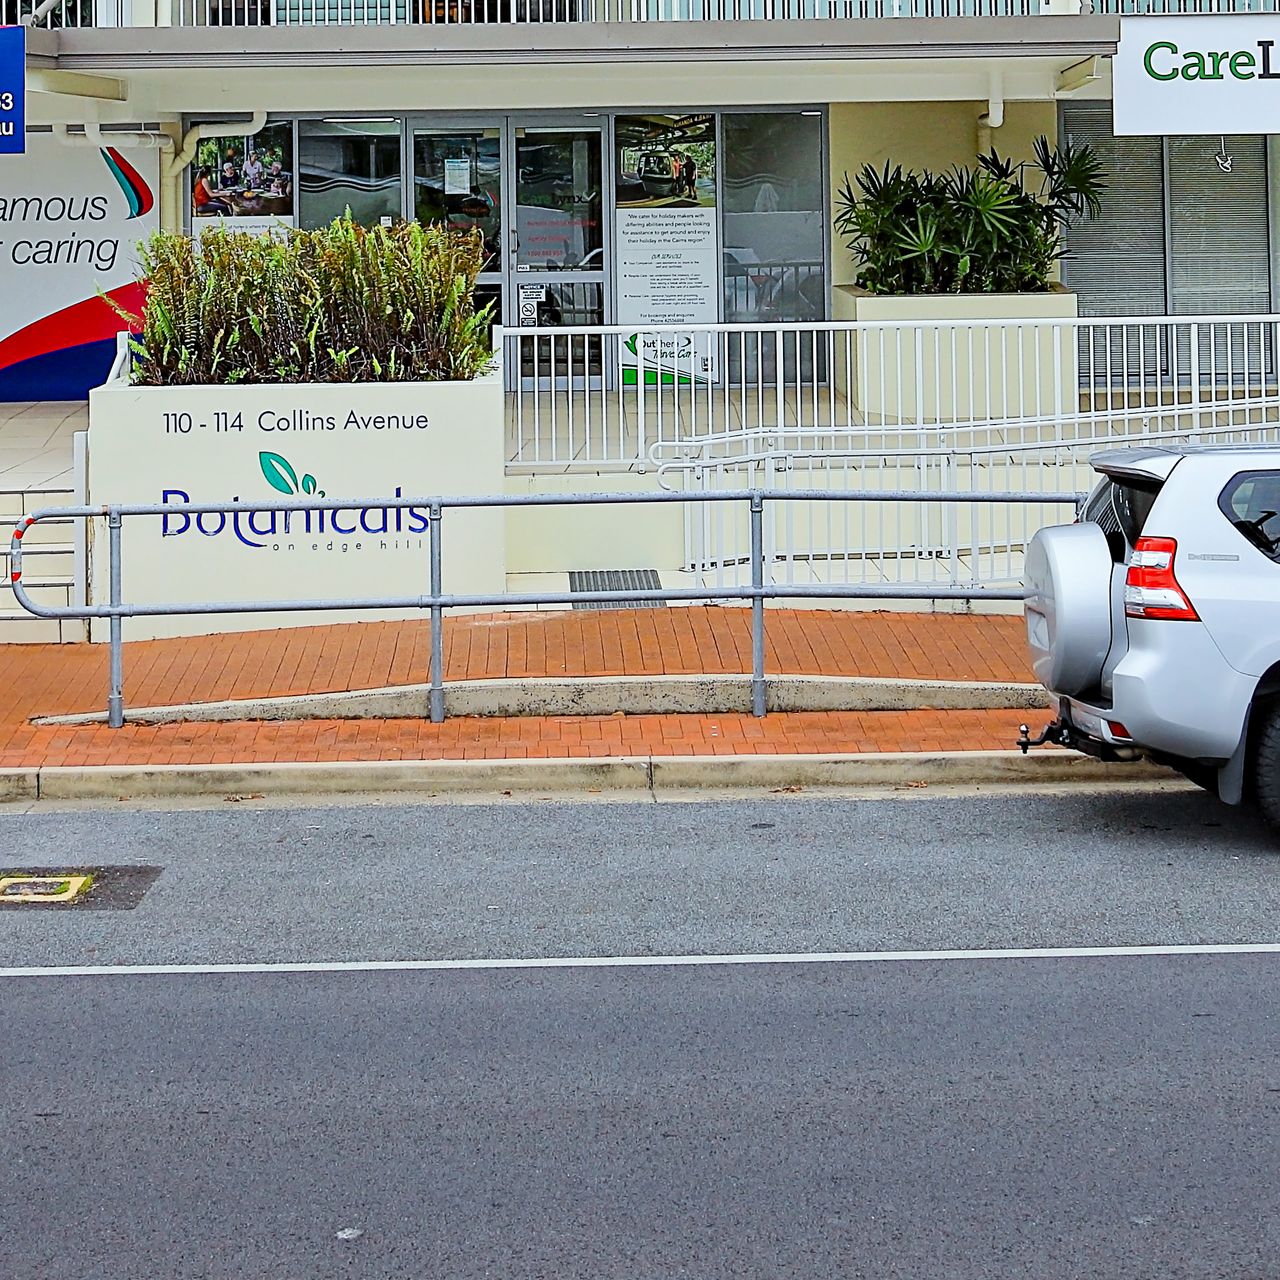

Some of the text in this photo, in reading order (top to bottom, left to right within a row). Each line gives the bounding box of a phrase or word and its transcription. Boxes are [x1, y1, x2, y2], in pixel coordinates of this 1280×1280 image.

[11, 234, 119, 272] caring
[162, 412, 193, 434] 110
[213, 411, 244, 433] 114
[258, 409, 336, 433] Collins
[343, 411, 429, 431] Avenue
[162, 486, 430, 548] Botanicals
[272, 539, 423, 553] on edge hill
